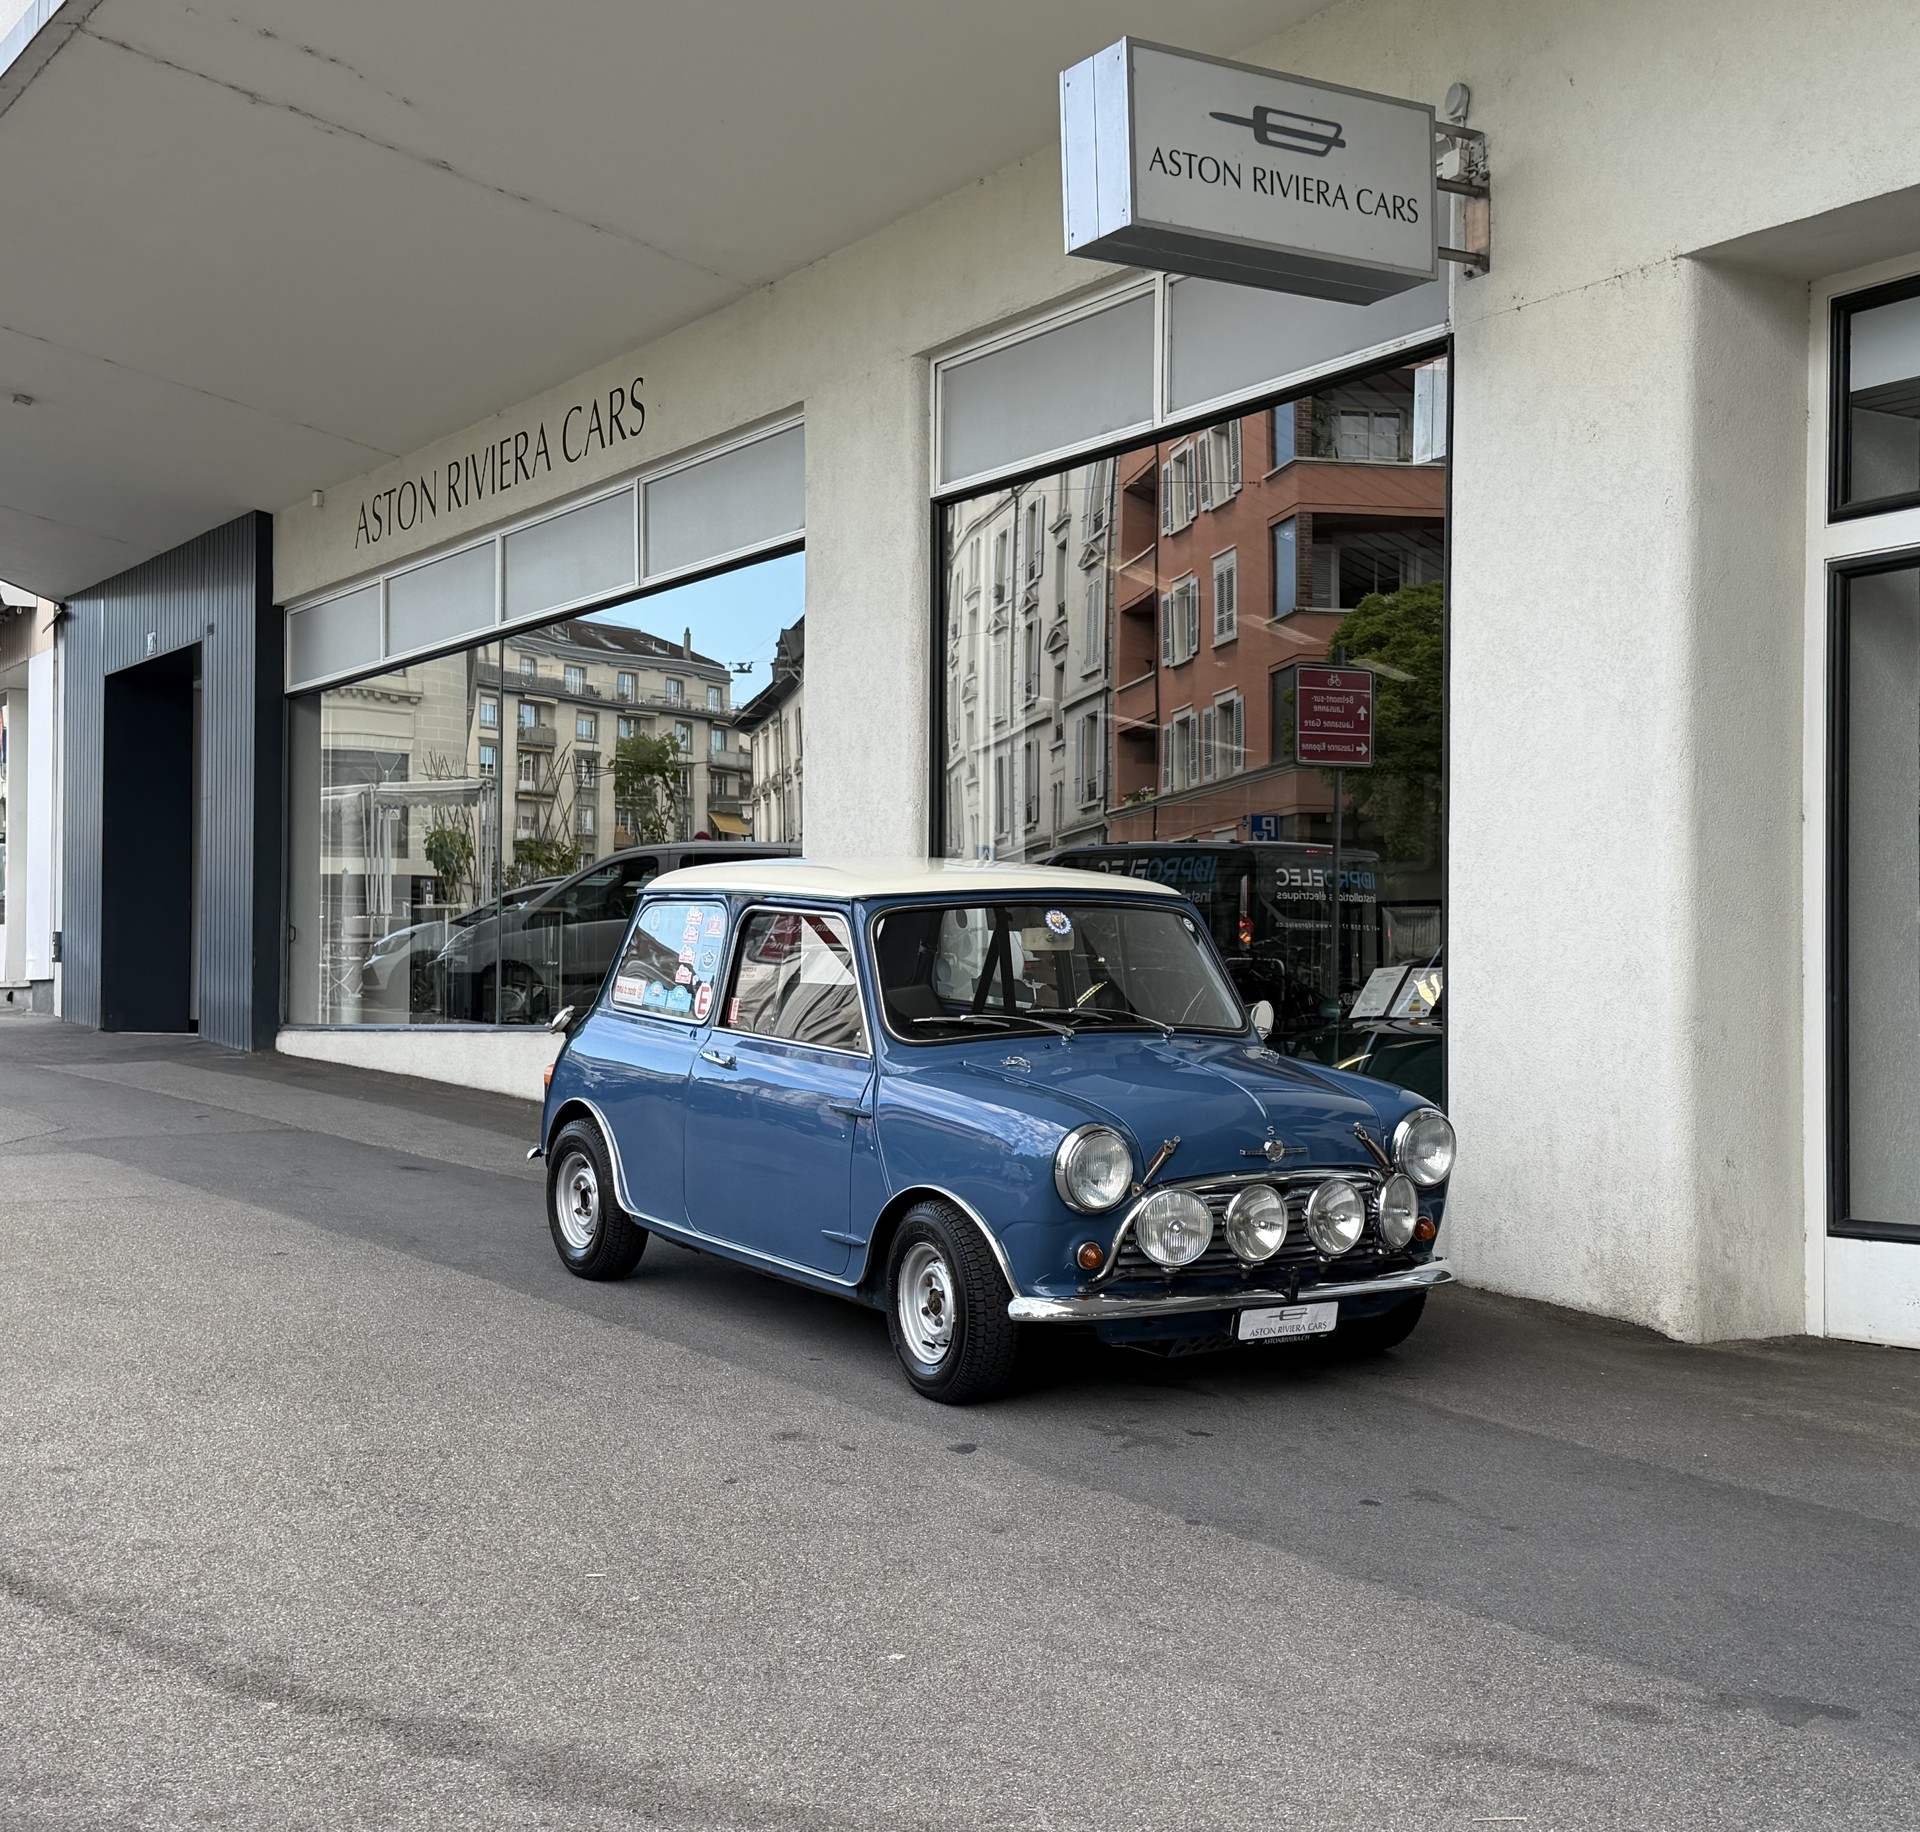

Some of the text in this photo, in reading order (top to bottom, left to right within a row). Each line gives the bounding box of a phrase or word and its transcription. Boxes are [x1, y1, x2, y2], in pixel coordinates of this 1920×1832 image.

[1149, 146, 1419, 224] ASTON RIVIERA CARS
[355, 377, 646, 549] ASTON RIVIERA CARS
[697, 986, 710, 1015] E
[1266, 1125, 1275, 1136] S
[1249, 1321, 1327, 1337] ASTON RIVIERA CARS
[1263, 1335, 1310, 1345] ASTONRIVIERA.CH
